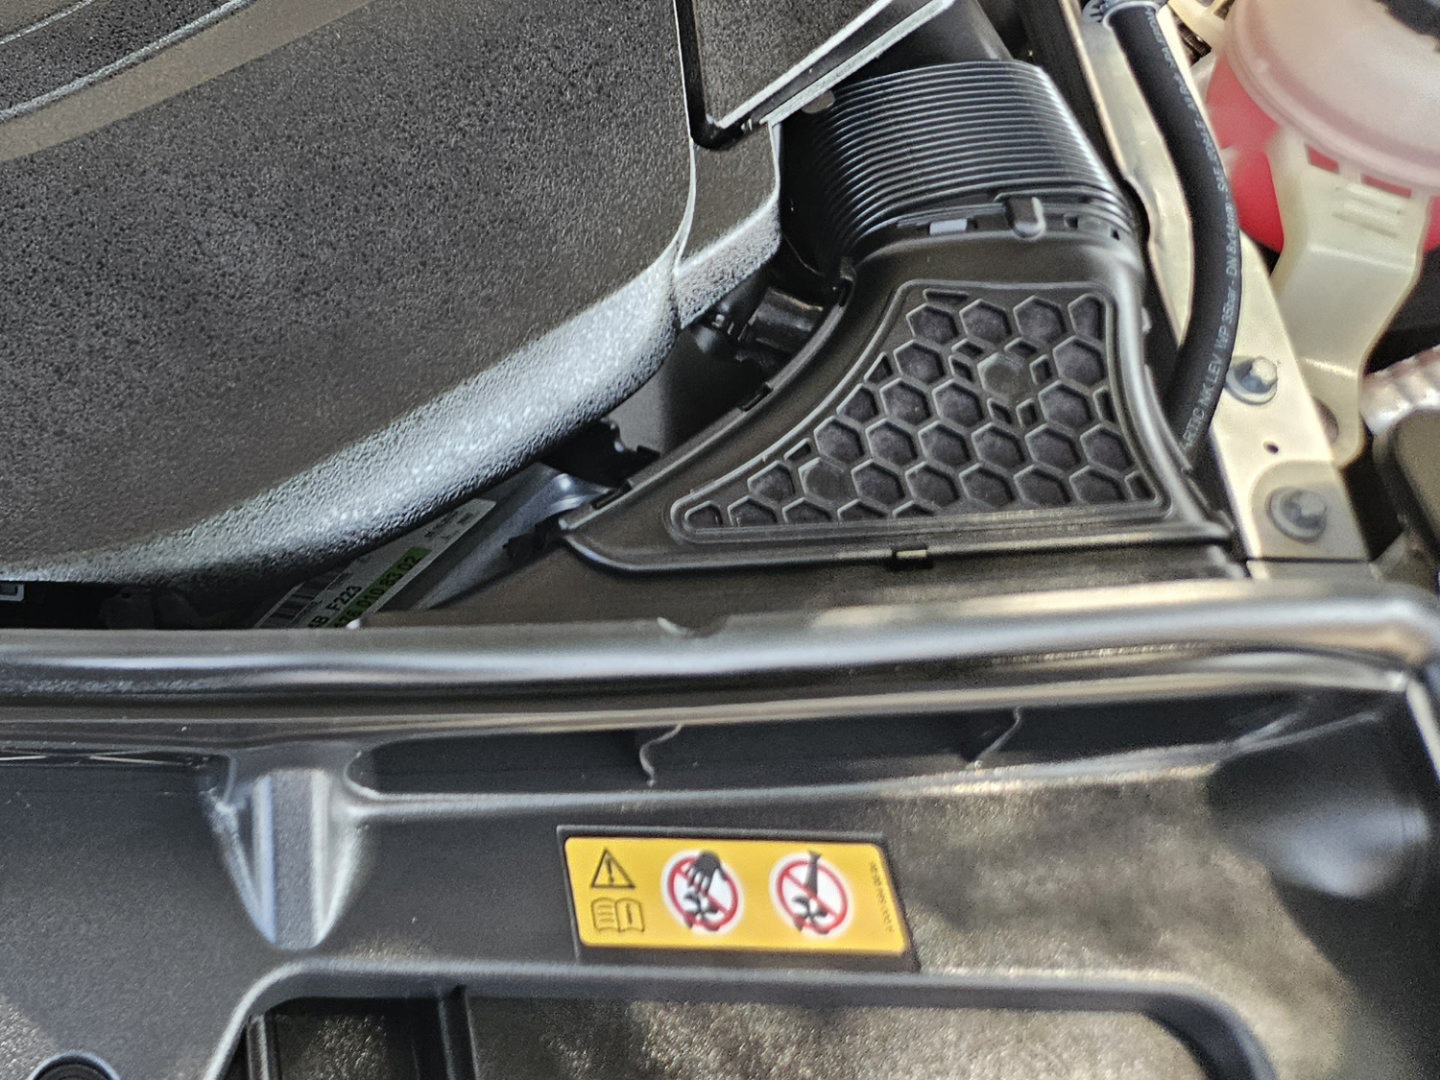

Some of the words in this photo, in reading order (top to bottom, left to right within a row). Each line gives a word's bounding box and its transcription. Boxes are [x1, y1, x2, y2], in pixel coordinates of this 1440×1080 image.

[1226, 256, 1237, 276] DN
[1221, 286, 1237, 324] 35bar
[1214, 326, 1229, 349] WP
[1208, 353, 1224, 384] LEV
[325, 586, 362, 611] F223
